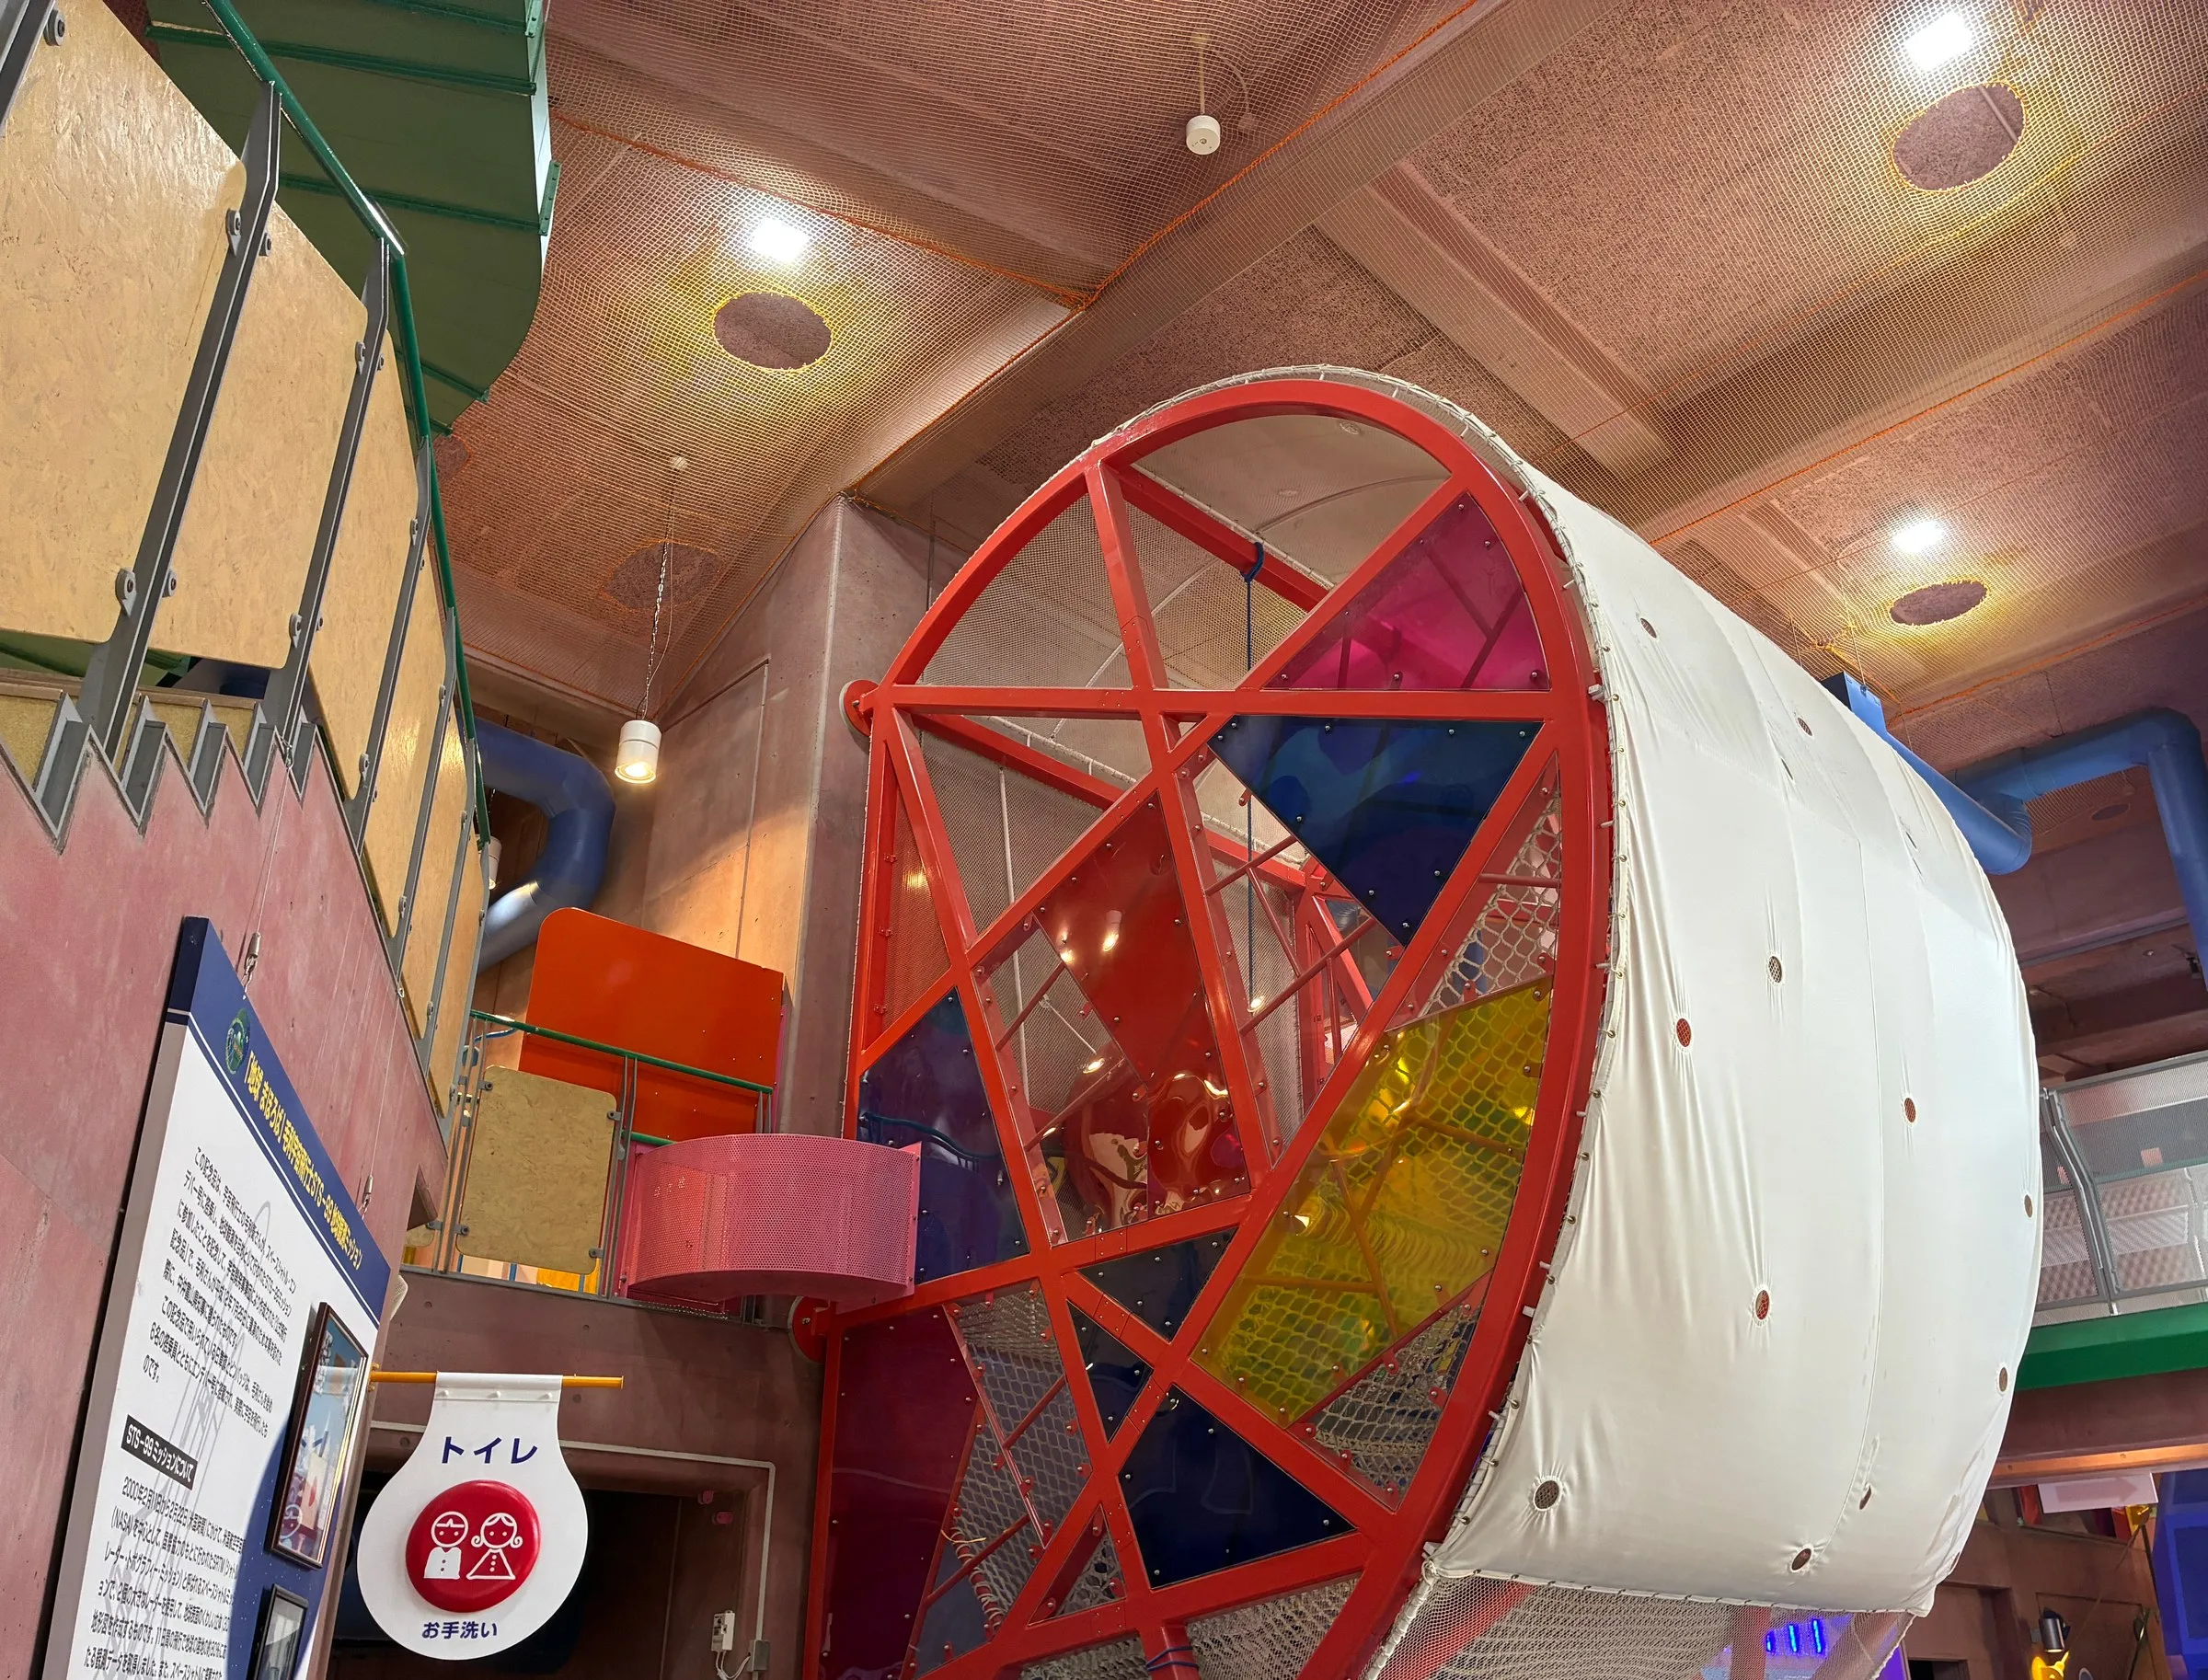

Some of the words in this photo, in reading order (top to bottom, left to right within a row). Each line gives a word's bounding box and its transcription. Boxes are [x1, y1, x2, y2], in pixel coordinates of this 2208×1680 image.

[141, 1352, 162, 1385] のです。
[442, 1436, 538, 1464] トイレ
[421, 1620, 498, 1640] お手洗い
